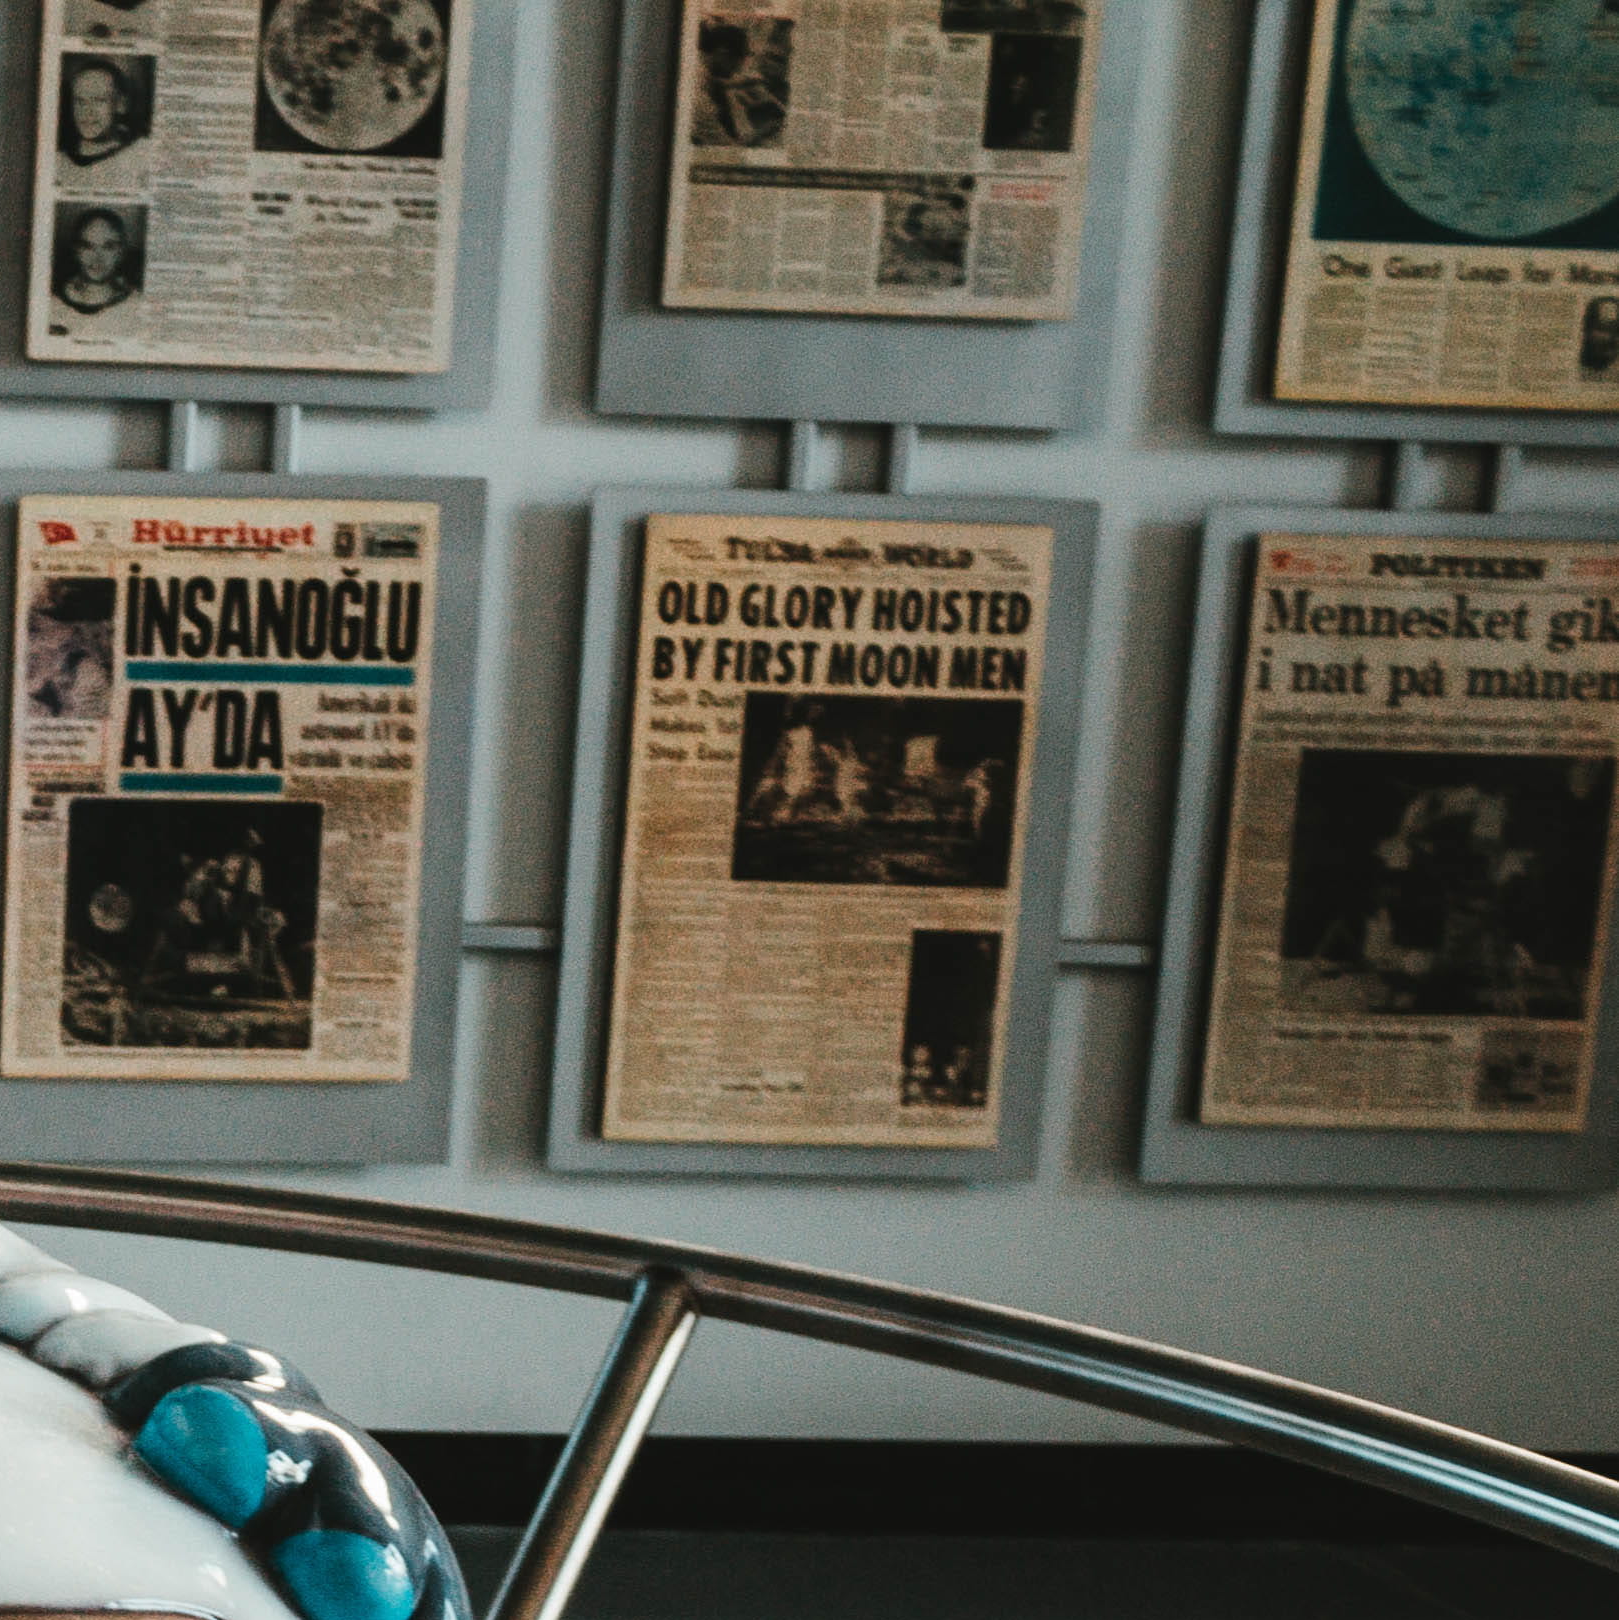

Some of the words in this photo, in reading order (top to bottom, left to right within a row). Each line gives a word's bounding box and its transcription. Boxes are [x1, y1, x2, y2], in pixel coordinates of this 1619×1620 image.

[132, 518, 314, 559] Hürriyet
[125, 563, 422, 662] İNSANOĞLU
[657, 580, 729, 626] OLD
[740, 582, 862, 631] GLORY
[872, 588, 1032, 635] HOISTED
[1265, 588, 1529, 641] Mennesket
[652, 637, 704, 681] BY
[713, 639, 820, 685] FIRST
[828, 642, 940, 689] MOON
[949, 646, 1027, 691] MEN
[1291, 654, 1369, 695] nat
